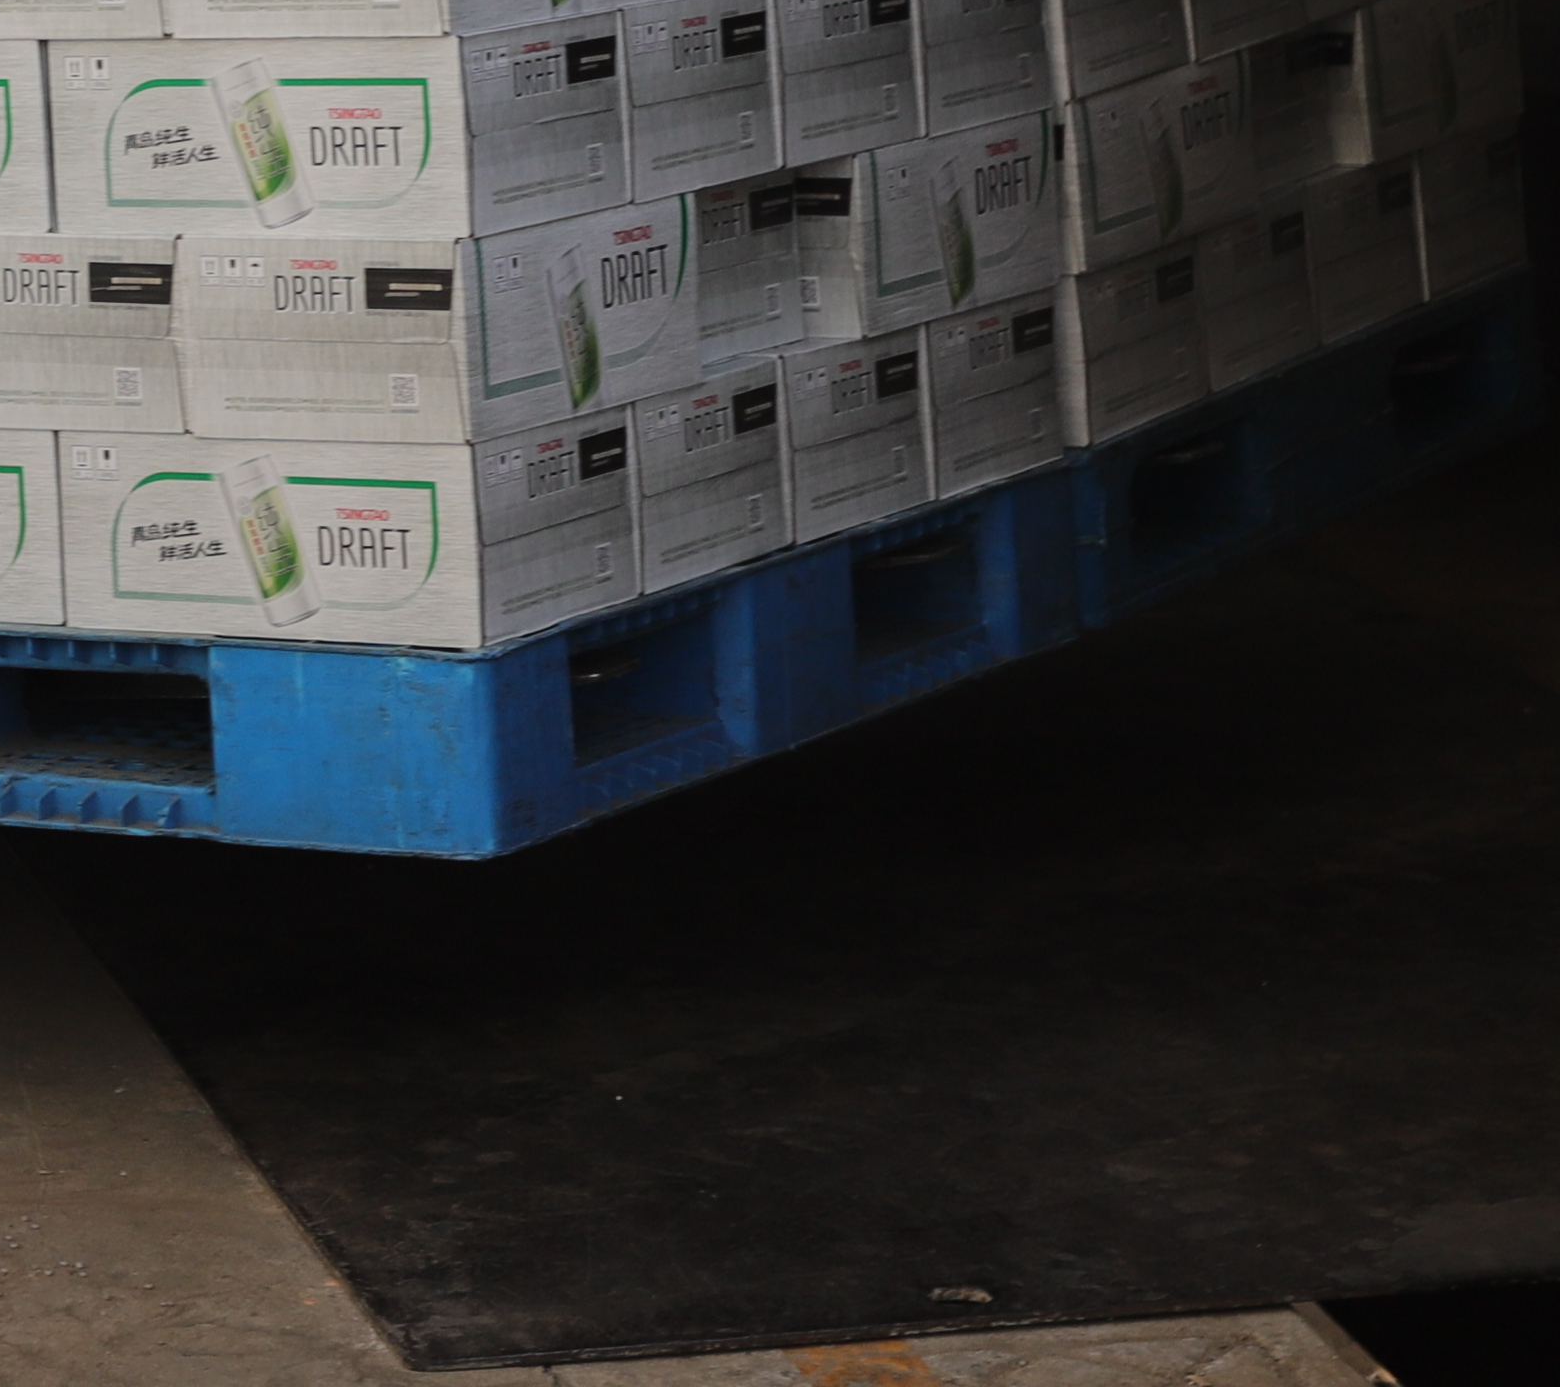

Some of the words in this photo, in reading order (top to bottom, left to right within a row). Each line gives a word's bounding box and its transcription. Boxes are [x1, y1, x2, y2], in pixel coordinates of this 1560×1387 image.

[327, 107, 383, 120] TSINGTAO
[310, 126, 403, 166] DRAFT
[974, 155, 1032, 215] DRAFT
[18, 252, 65, 265] TSINGTAO
[290, 258, 339, 271] TSINGTAO
[601, 244, 668, 309] DRAFT
[3, 268, 79, 304] DRAFT
[275, 275, 355, 311] DRAFT
[335, 507, 392, 522] TSINGTAO
[318, 526, 411, 569] DRAFT
